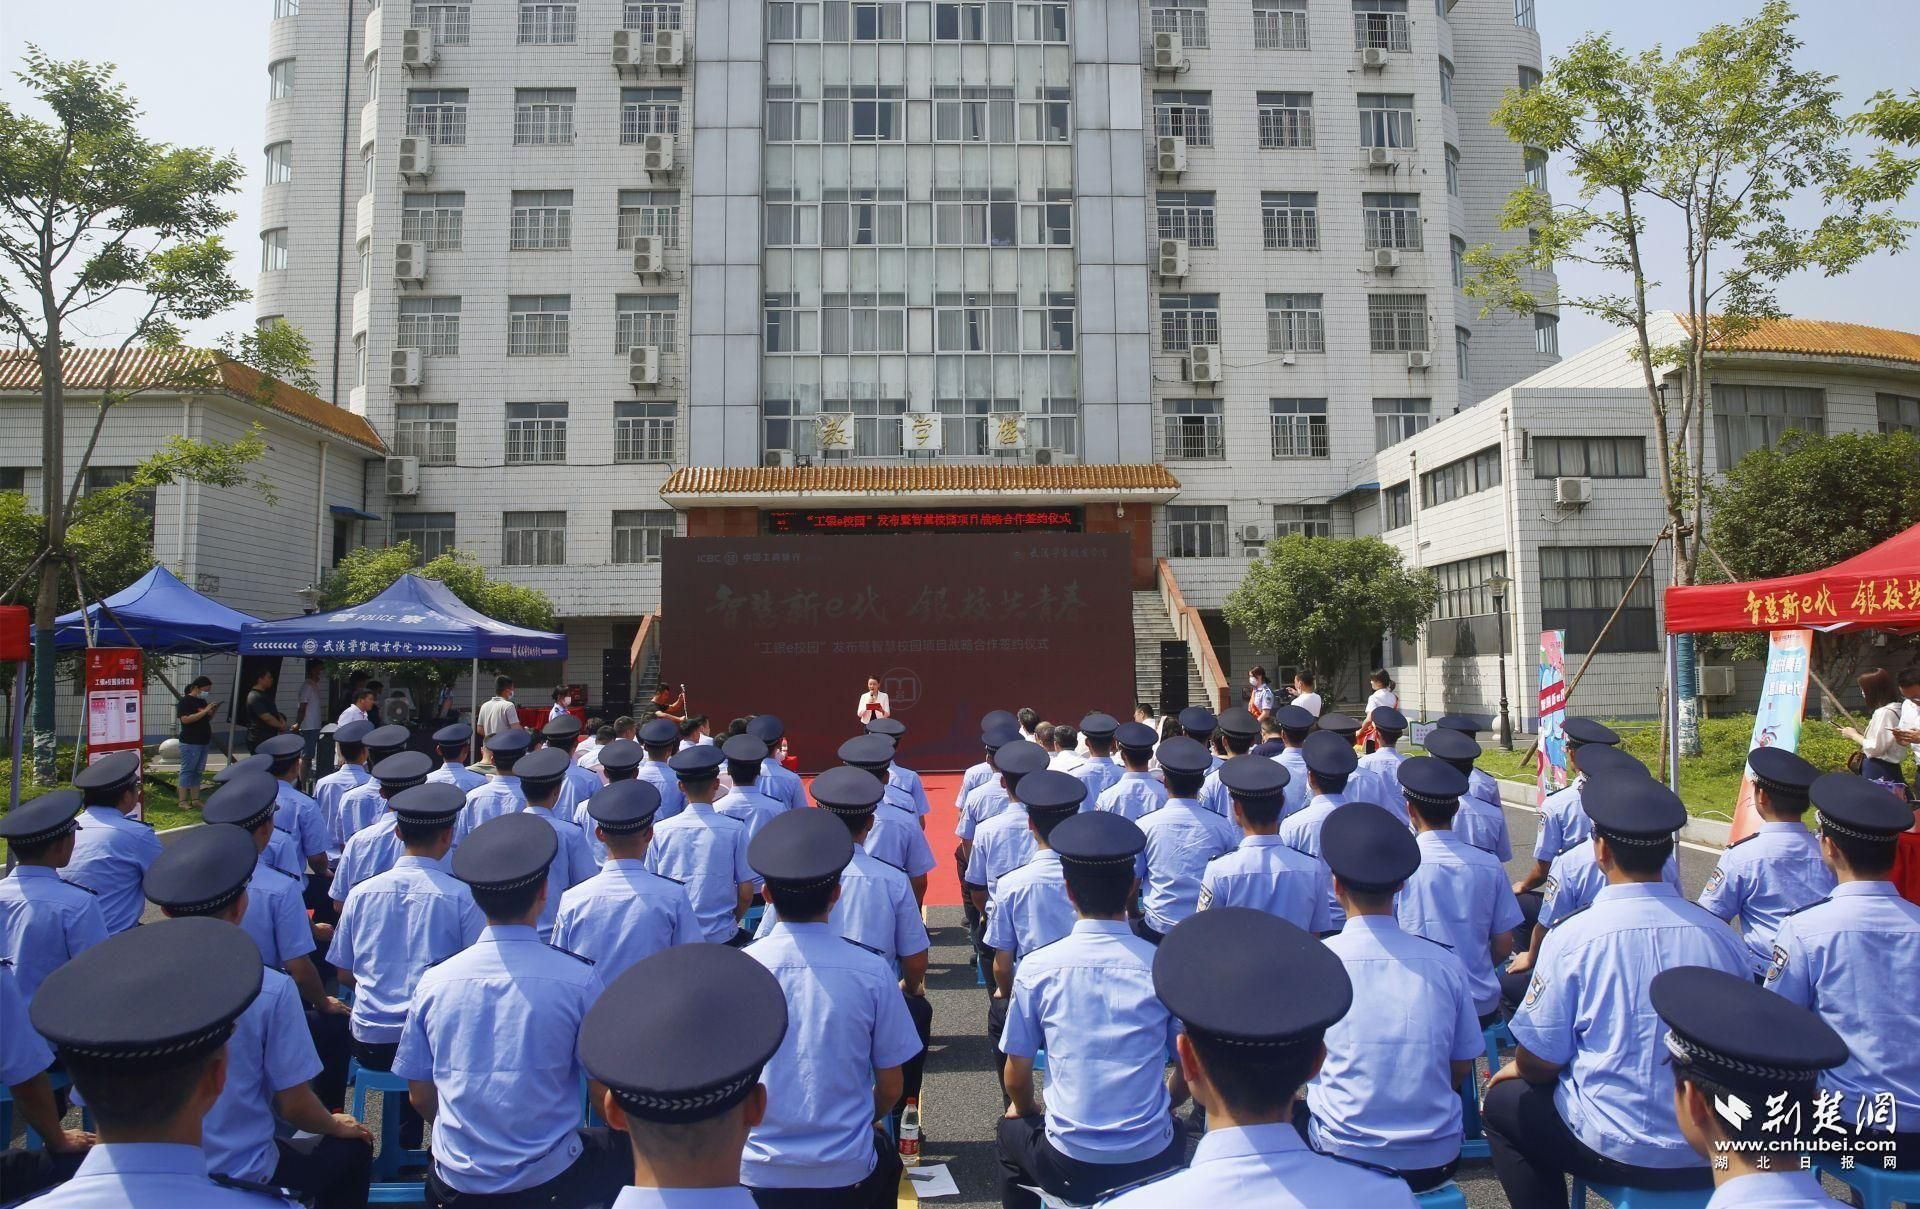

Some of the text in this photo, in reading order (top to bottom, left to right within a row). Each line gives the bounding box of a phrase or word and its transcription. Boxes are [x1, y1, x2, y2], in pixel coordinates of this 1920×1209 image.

[1743, 583, 1838, 625] 智慧新e代
[355, 614, 397, 622] POLICE
